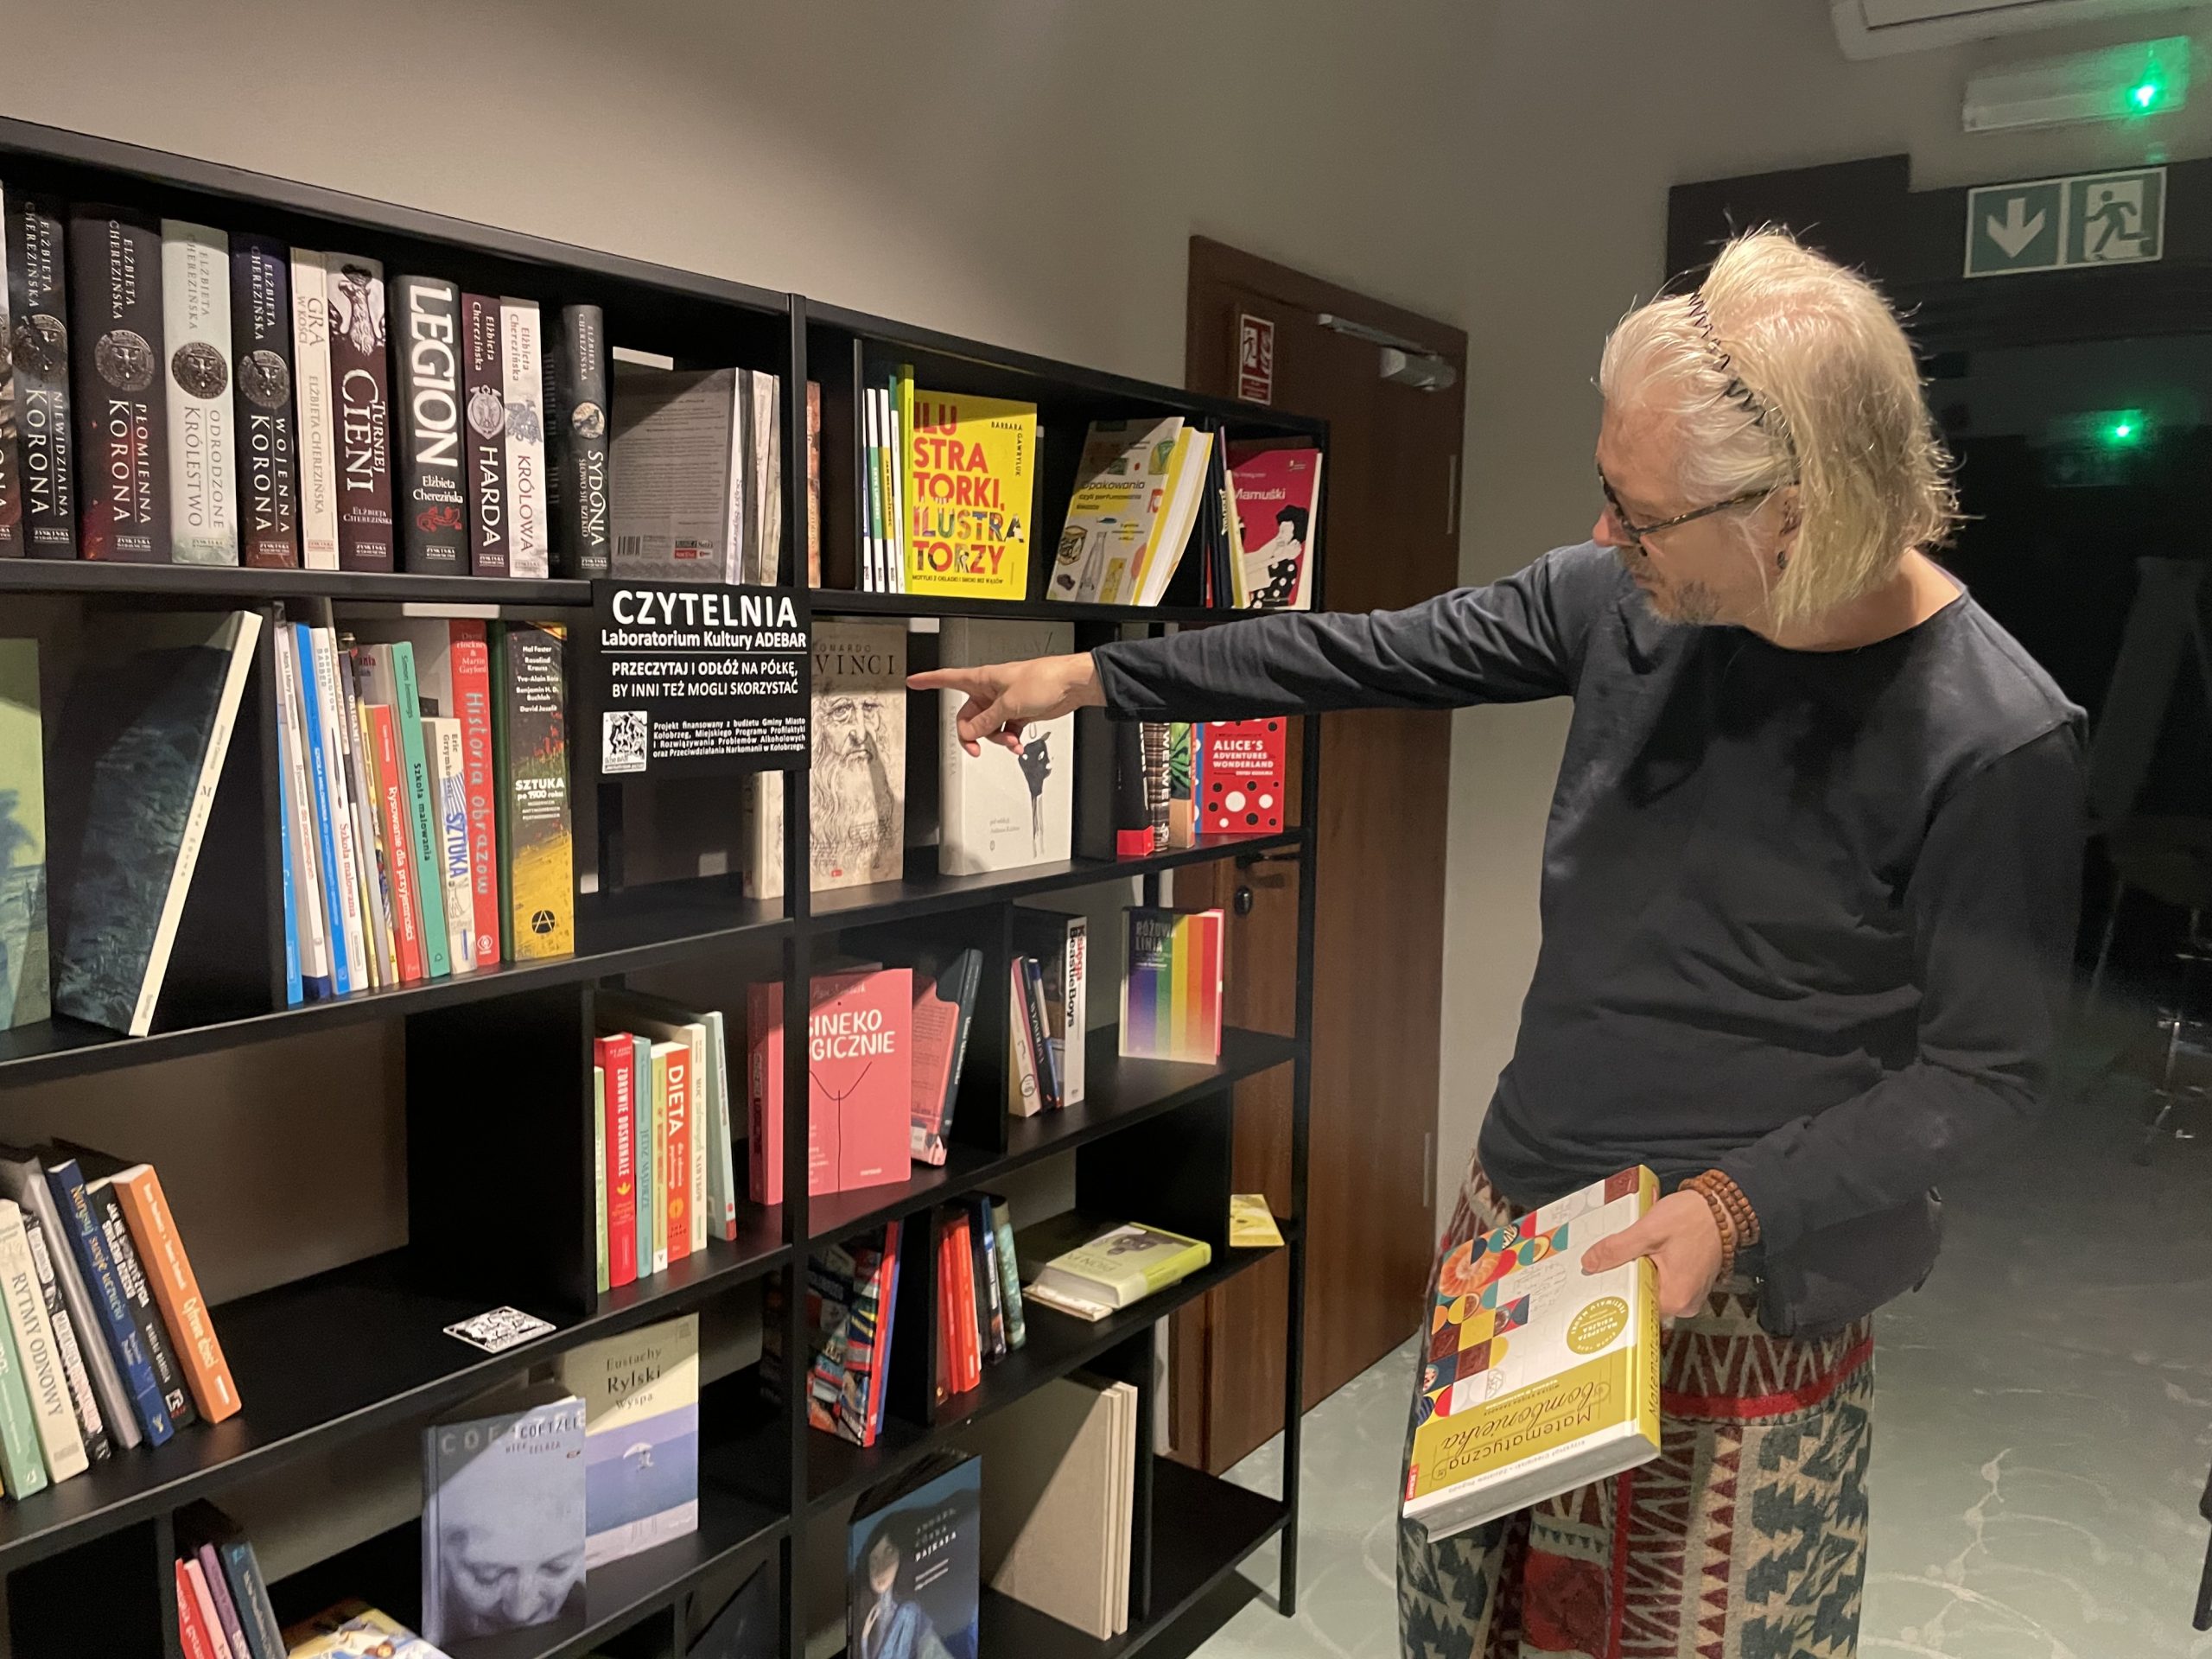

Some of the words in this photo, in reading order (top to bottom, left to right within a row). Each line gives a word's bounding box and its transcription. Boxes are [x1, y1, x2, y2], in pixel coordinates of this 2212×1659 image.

[297, 308, 308, 345] KOŚCI
[307, 297, 326, 346] GRA
[485, 316, 495, 362] Elżbieta
[308, 374, 321, 428] ELŻBIETA
[410, 284, 459, 467] LEGION
[342, 368, 380, 494] CIENI
[371, 400, 387, 474] TURNIEJ
[913, 401, 957, 435] ILU
[991, 421, 1024, 431] BARBARA
[25, 389, 51, 515] KORONA
[53, 391, 69, 518] NIEWIDZIALNA
[109, 399, 131, 524] KORONA
[134, 403, 153, 524] PŁOMIENNA
[183, 405, 204, 528] KRÓLESTWO
[208, 409, 226, 530] ODRODZONE
[251, 415, 273, 533] KORONA
[275, 417, 290, 534] WOJENNA
[913, 437, 988, 474] STRA
[413, 488, 464, 505] Cherezińska
[422, 475, 456, 490] Elżbieta
[480, 446, 502, 548] HARDA
[517, 454, 536, 553] KRÓLOWA
[588, 449, 607, 547] SYDONIA
[913, 472, 1006, 512] TORKI,
[913, 505, 1025, 543] ILUSTRA
[912, 540, 1006, 575] TORZY
[613, 589, 798, 628] CZYTELNIA
[601, 628, 701, 647] Laboratorium
[703, 631, 752, 651] Kultury
[754, 632, 806, 647] ADEBAR
[815, 654, 894, 675] VINCI
[324, 648, 335, 711] BARRINGTON
[459, 665, 486, 674] Gayford
[516, 686, 545, 695] Benjamin
[612, 662, 689, 676] PRZECZYTAJ
[691, 662, 695, 676] I
[697, 659, 739, 676] ODŁÓŻ
[741, 662, 759, 675] NA
[760, 658, 798, 677] PÓŁKĘ,
[613, 683, 629, 697] BY
[632, 683, 659, 697] INNI
[663, 680, 685, 696] TEŻ
[688, 683, 728, 696] MOGLI
[730, 678, 798, 695] SKORZYSTAĆ
[465, 692, 486, 786] Historia
[653, 721, 679, 731] Projekt
[682, 721, 723, 729] finansowany
[762, 718, 783, 727] Gminy
[785, 717, 806, 726] Miasto
[695, 729, 732, 739] Miejskiego
[735, 728, 767, 736] Programu
[718, 736, 757, 746] Problemów
[760, 734, 806, 743] Alkoholowych
[726, 745, 762, 753] Narkomanii
[414, 763, 423, 800] Szkoła
[515, 778, 565, 791] SZTUKA
[517, 792, 527, 802] po
[528, 790, 547, 799] 1900
[388, 785, 402, 849] Rysowanie
[417, 804, 431, 862] malowania
[395, 849, 406, 868] dla
[446, 812, 467, 879] SZTUKA
[397, 869, 414, 942] przyjemności
[1067, 925, 1078, 1028] BeastieBoys
[1076, 924, 1086, 983] Księga
[616, 1067, 629, 1121] ZDROWIE
[668, 1065, 685, 1137] DIETA
[617, 1122, 631, 1178] DOSKONAŁE
[106, 1202, 118, 1221] JAK
[112, 1219, 124, 1236] NIE
[70, 1183, 99, 1236] Narysuj
[88, 1236, 106, 1273] swoje
[101, 1271, 124, 1321] uczucia
[11, 1273, 41, 1337] RYTMY
[29, 1337, 65, 1417] ODNOWY
[1577, 1321, 1618, 1342] NAJLEPSZA
[607, 1367, 662, 1395] Rylski
[614, 1390, 654, 1411] Wyspa
[1440, 1382, 1592, 1458] bombonierka
[1448, 1405, 1592, 1471] Matematyczna
